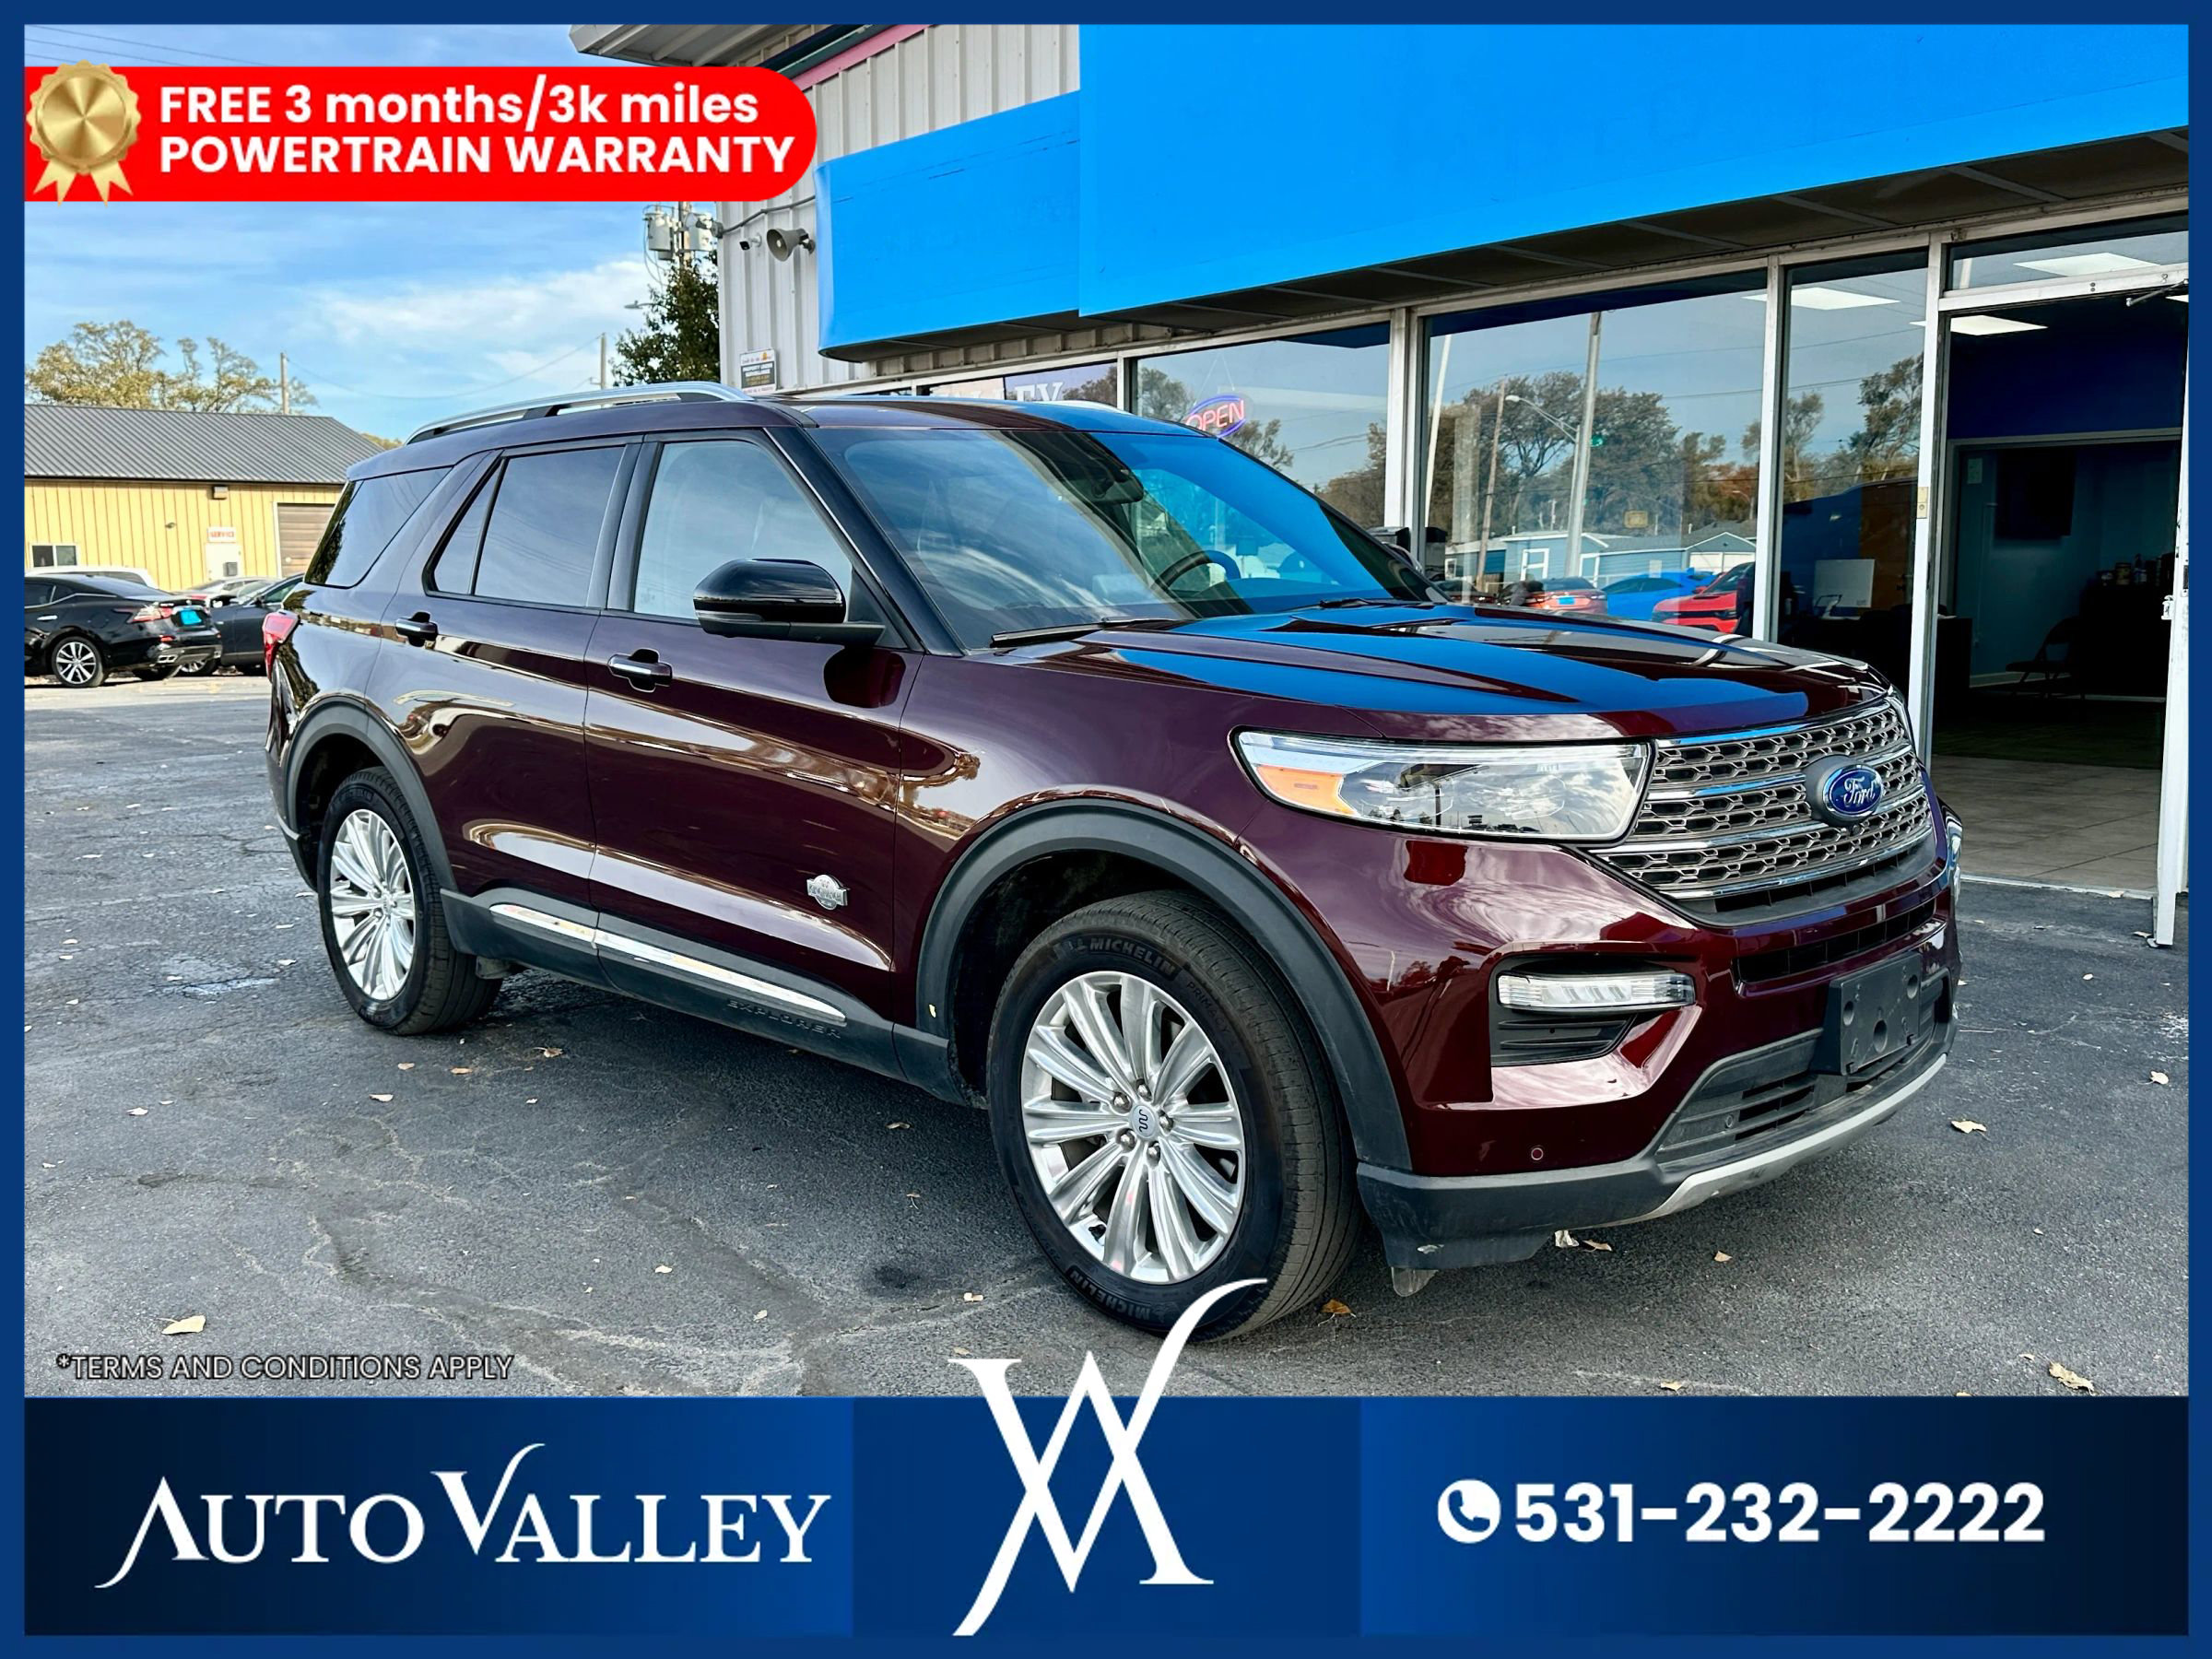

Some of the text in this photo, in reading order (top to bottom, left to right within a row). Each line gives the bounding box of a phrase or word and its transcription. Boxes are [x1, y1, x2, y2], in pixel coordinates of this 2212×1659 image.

[1185, 398, 1245, 431] OPEN
[1843, 775, 1877, 808] Ford
[1089, 936, 1178, 976] MICHELIN
[727, 999, 841, 1039] EXPLORER
[1185, 980, 1232, 1034] PRIMACY
[1069, 1270, 1151, 1321] MICHELIN
